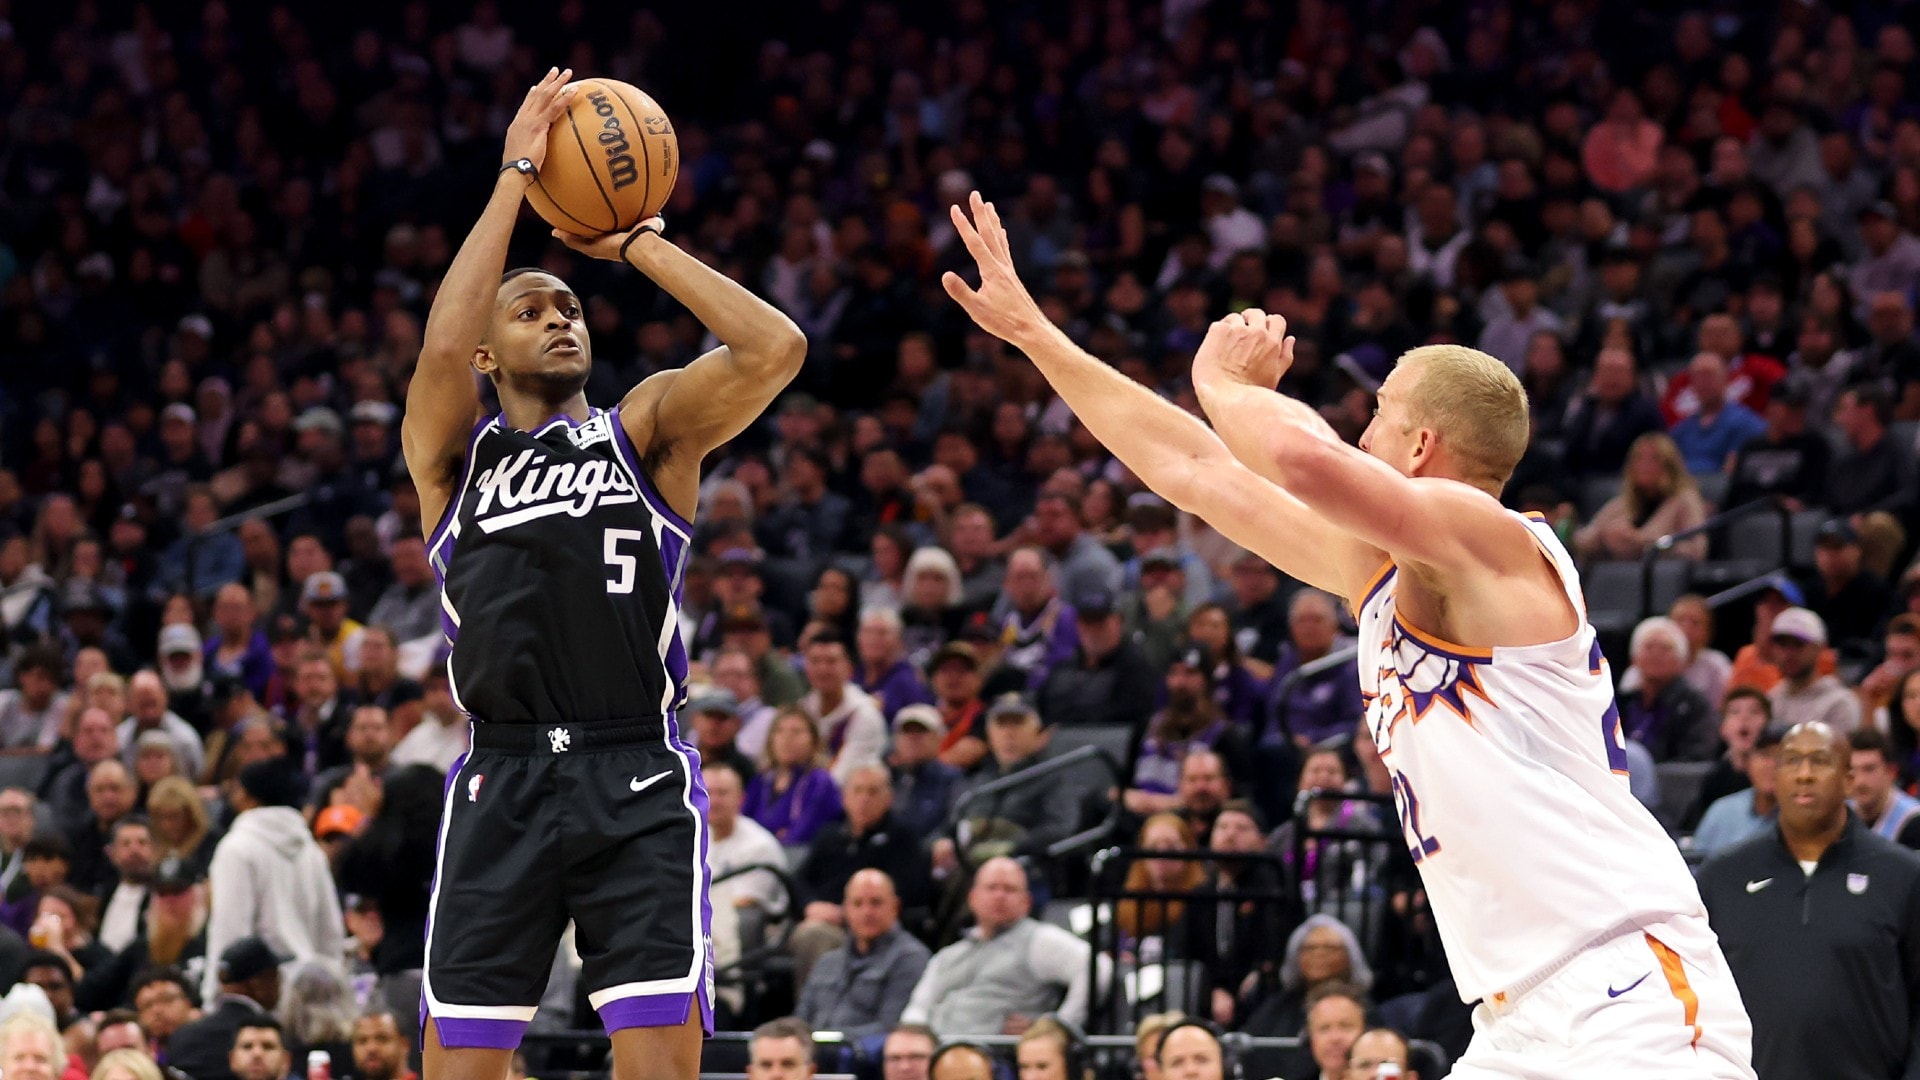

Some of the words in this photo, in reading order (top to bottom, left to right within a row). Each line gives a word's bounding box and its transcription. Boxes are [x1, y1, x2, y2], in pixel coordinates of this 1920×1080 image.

[586, 90, 639, 193] Wilson
[474, 448, 639, 518] Kings
[603, 527, 642, 595] 5
